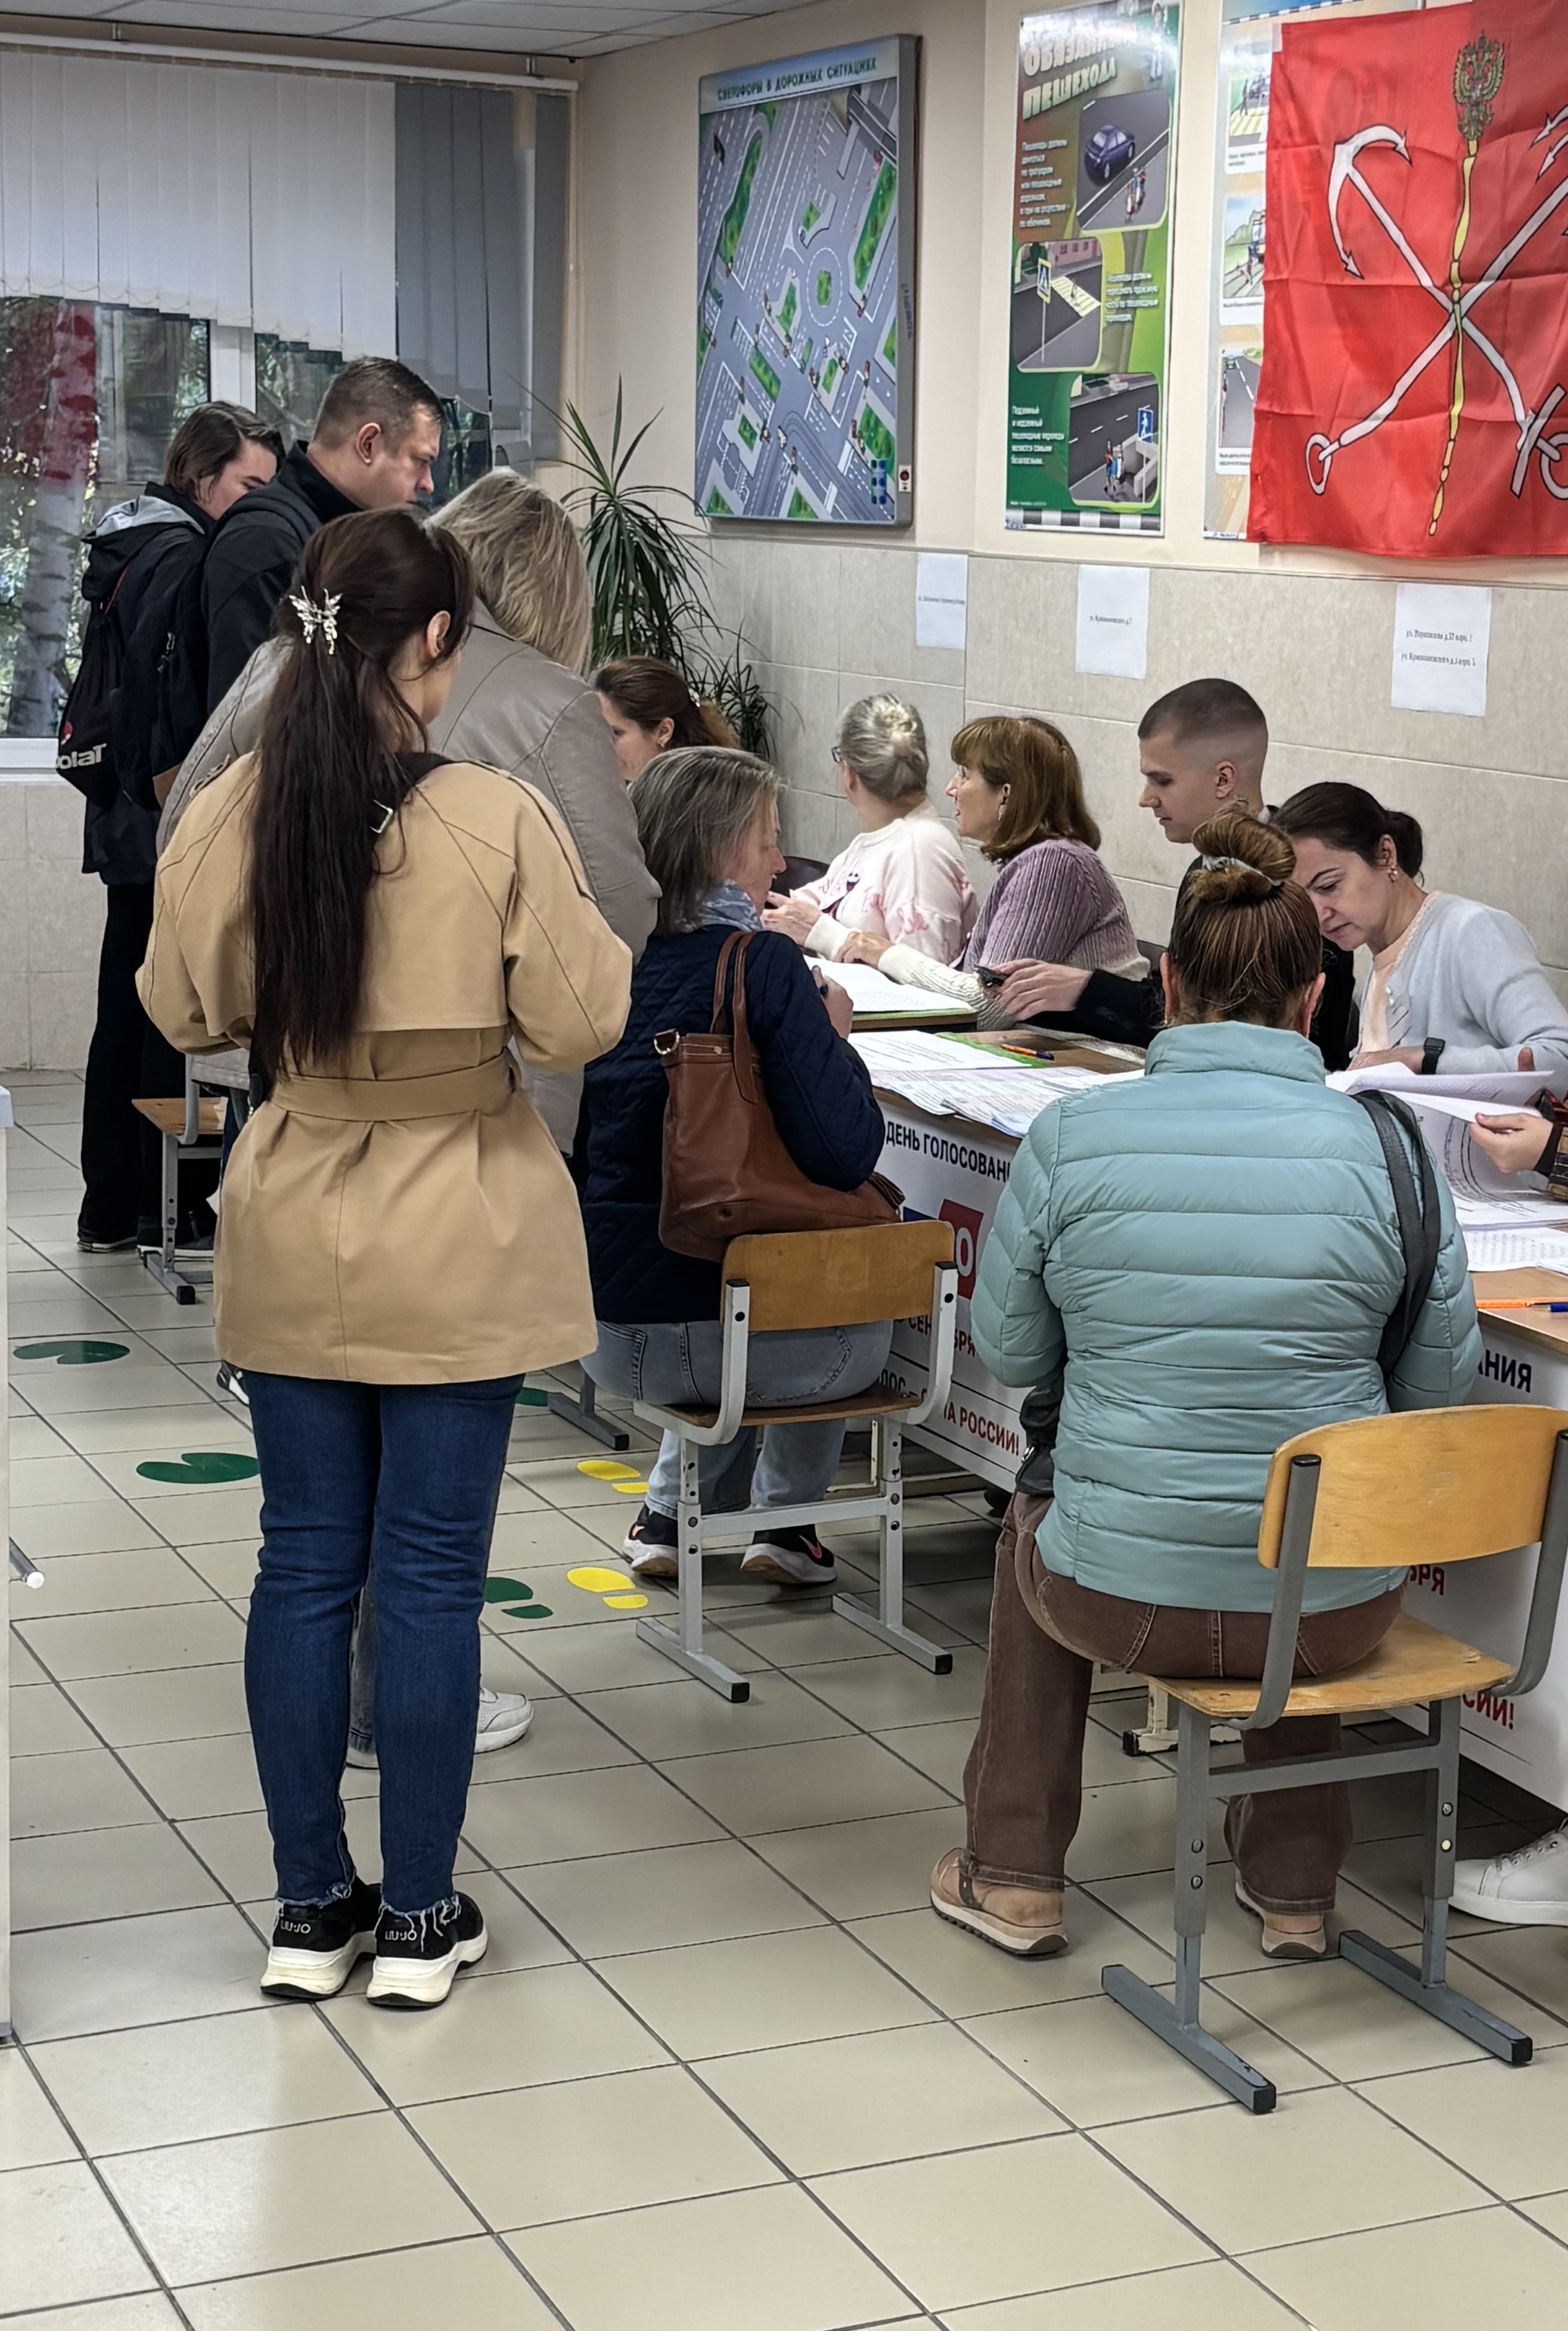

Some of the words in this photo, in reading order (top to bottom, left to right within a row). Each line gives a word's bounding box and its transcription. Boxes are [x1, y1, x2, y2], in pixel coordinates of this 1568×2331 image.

[774, 68, 823, 92] ДОРОЖНЫХ
[826, 57, 877, 80] СИТУАЦИЯХ
[1022, 56, 1117, 121] ПЕШЕХОДА
[885, 1120, 920, 1151] ДЕНЬ
[959, 1405, 1019, 1456] РОССИИ!
